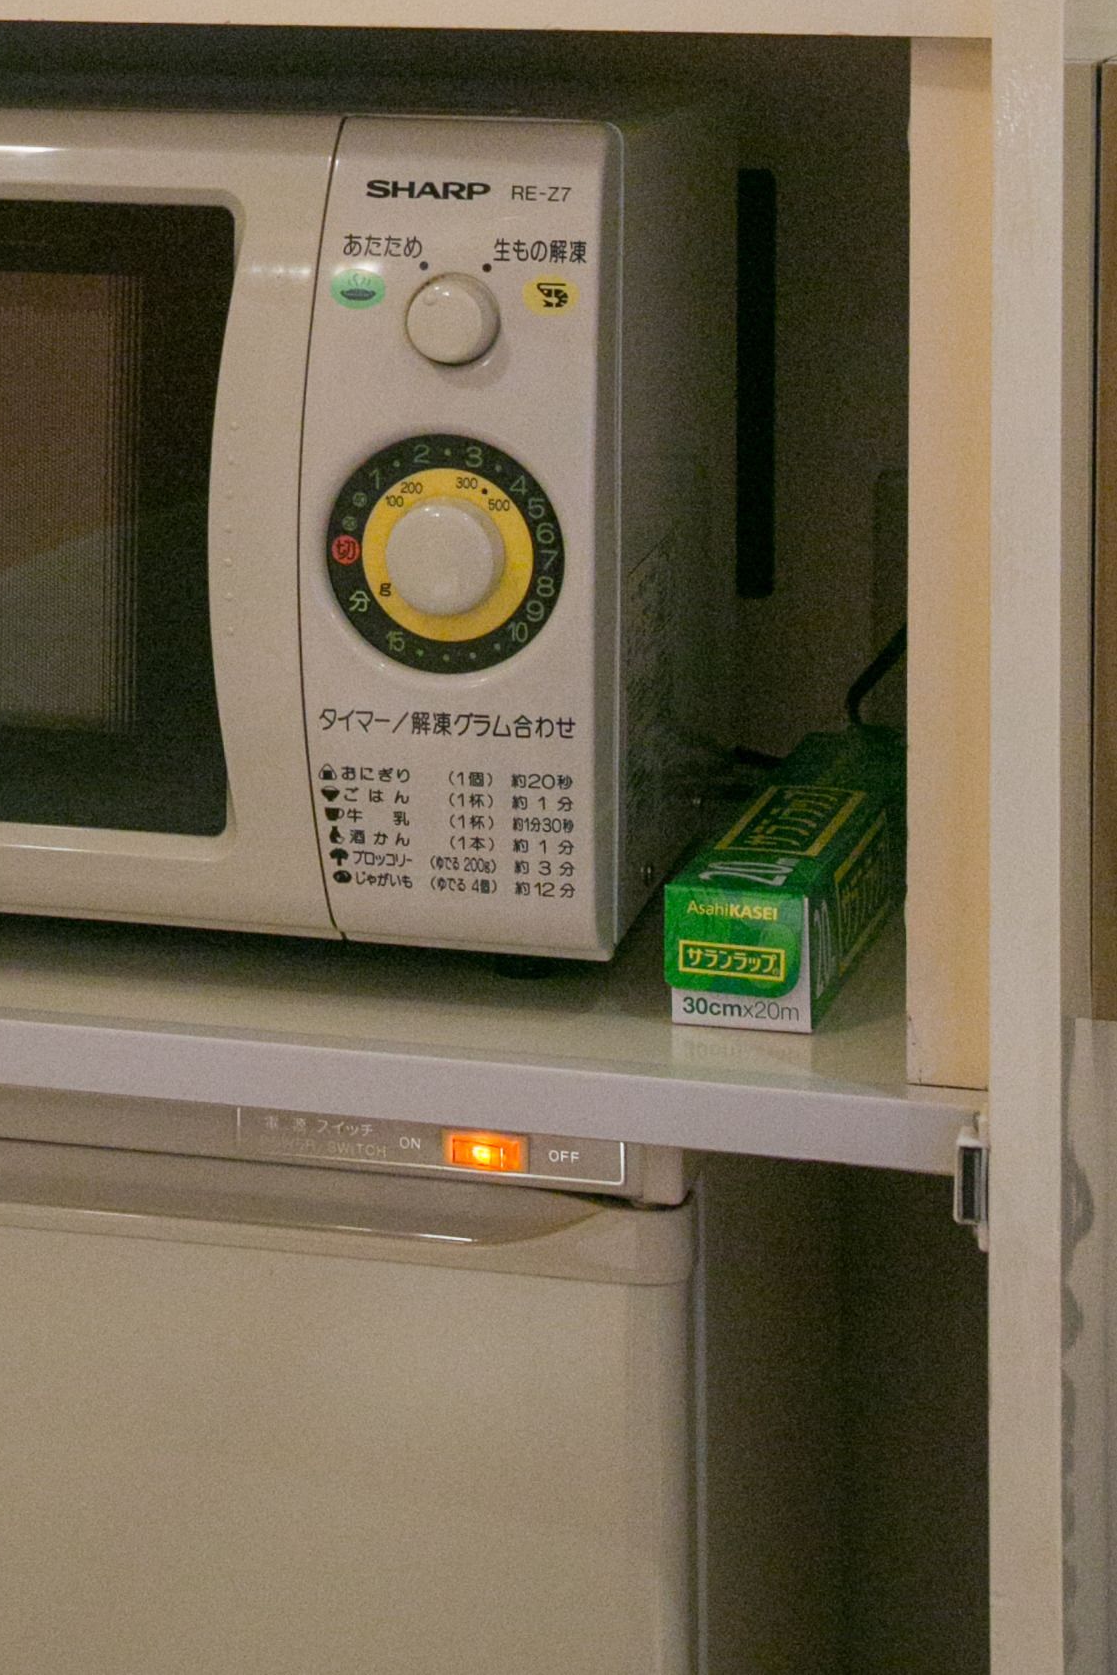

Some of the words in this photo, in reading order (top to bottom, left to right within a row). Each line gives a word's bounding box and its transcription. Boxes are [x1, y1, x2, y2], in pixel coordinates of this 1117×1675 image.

[366, 179, 491, 200] SHARP
[511, 185, 572, 202] RE-Z7
[343, 234, 424, 258] あたため
[493, 237, 588, 264] 生もの解凍
[414, 444, 431, 464] 2
[465, 446, 484, 468] 3
[369, 469, 381, 490] 1
[400, 482, 424, 495] 200
[456, 477, 479, 490] 300
[510, 476, 528, 496] 4
[385, 495, 404, 508] 100
[488, 498, 511, 512] 500
[528, 498, 546, 519] 5
[536, 523, 555, 544] 6
[336, 539, 356, 561] 切
[540, 551, 559, 571] 7
[379, 582, 392, 597] g
[536, 577, 555, 597] 8
[349, 590, 371, 612] 分
[526, 601, 545, 622] 9
[387, 631, 405, 652] 15
[507, 622, 529, 643] 10
[319, 708, 577, 740] タイマー／解凍グラム合わせ
[341, 766, 410, 783] おにぎり
[356, 871, 413, 889] じゃがいも
[687, 947, 778, 974] サランラップ
[399, 1136, 421, 1150] ON
[548, 1149, 580, 1164] OFF
